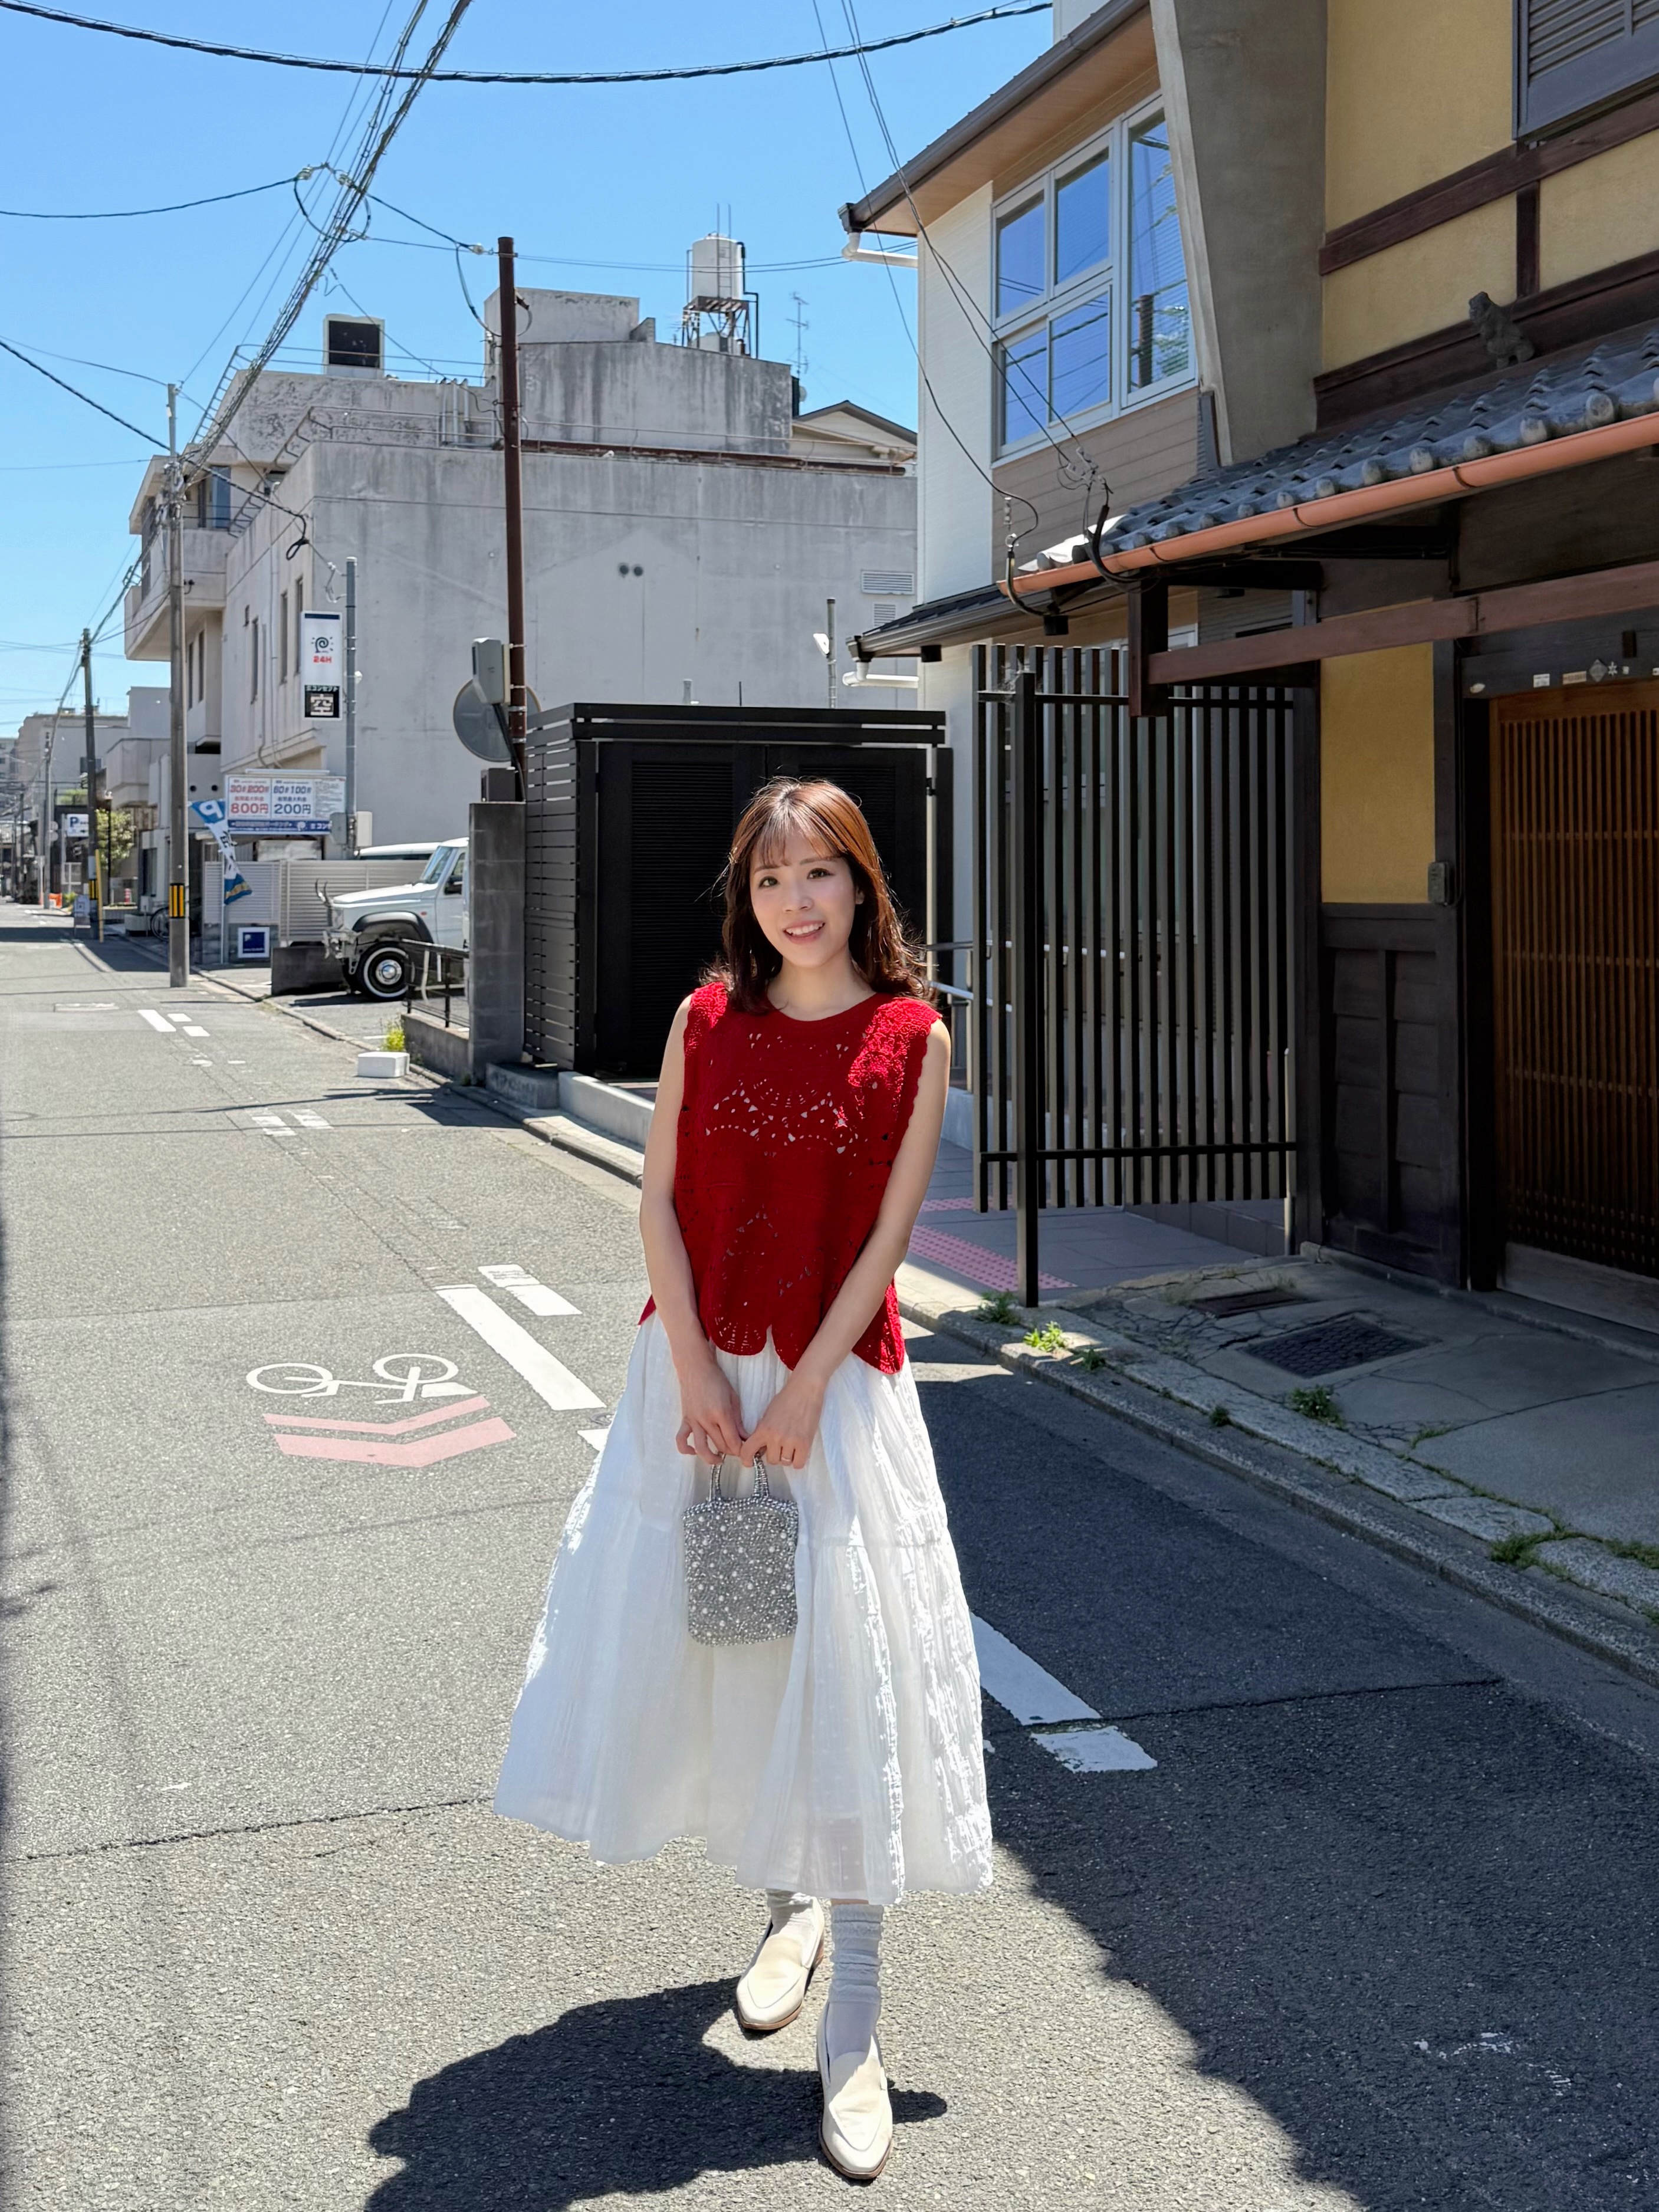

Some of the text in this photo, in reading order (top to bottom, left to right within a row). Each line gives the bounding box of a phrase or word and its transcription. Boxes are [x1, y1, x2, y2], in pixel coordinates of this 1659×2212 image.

[313, 655, 332, 663] 24H
[310, 693, 334, 716] 空
[231, 803, 268, 814] 800円
[274, 804, 311, 814] 200円
[70, 816, 79, 827] P
